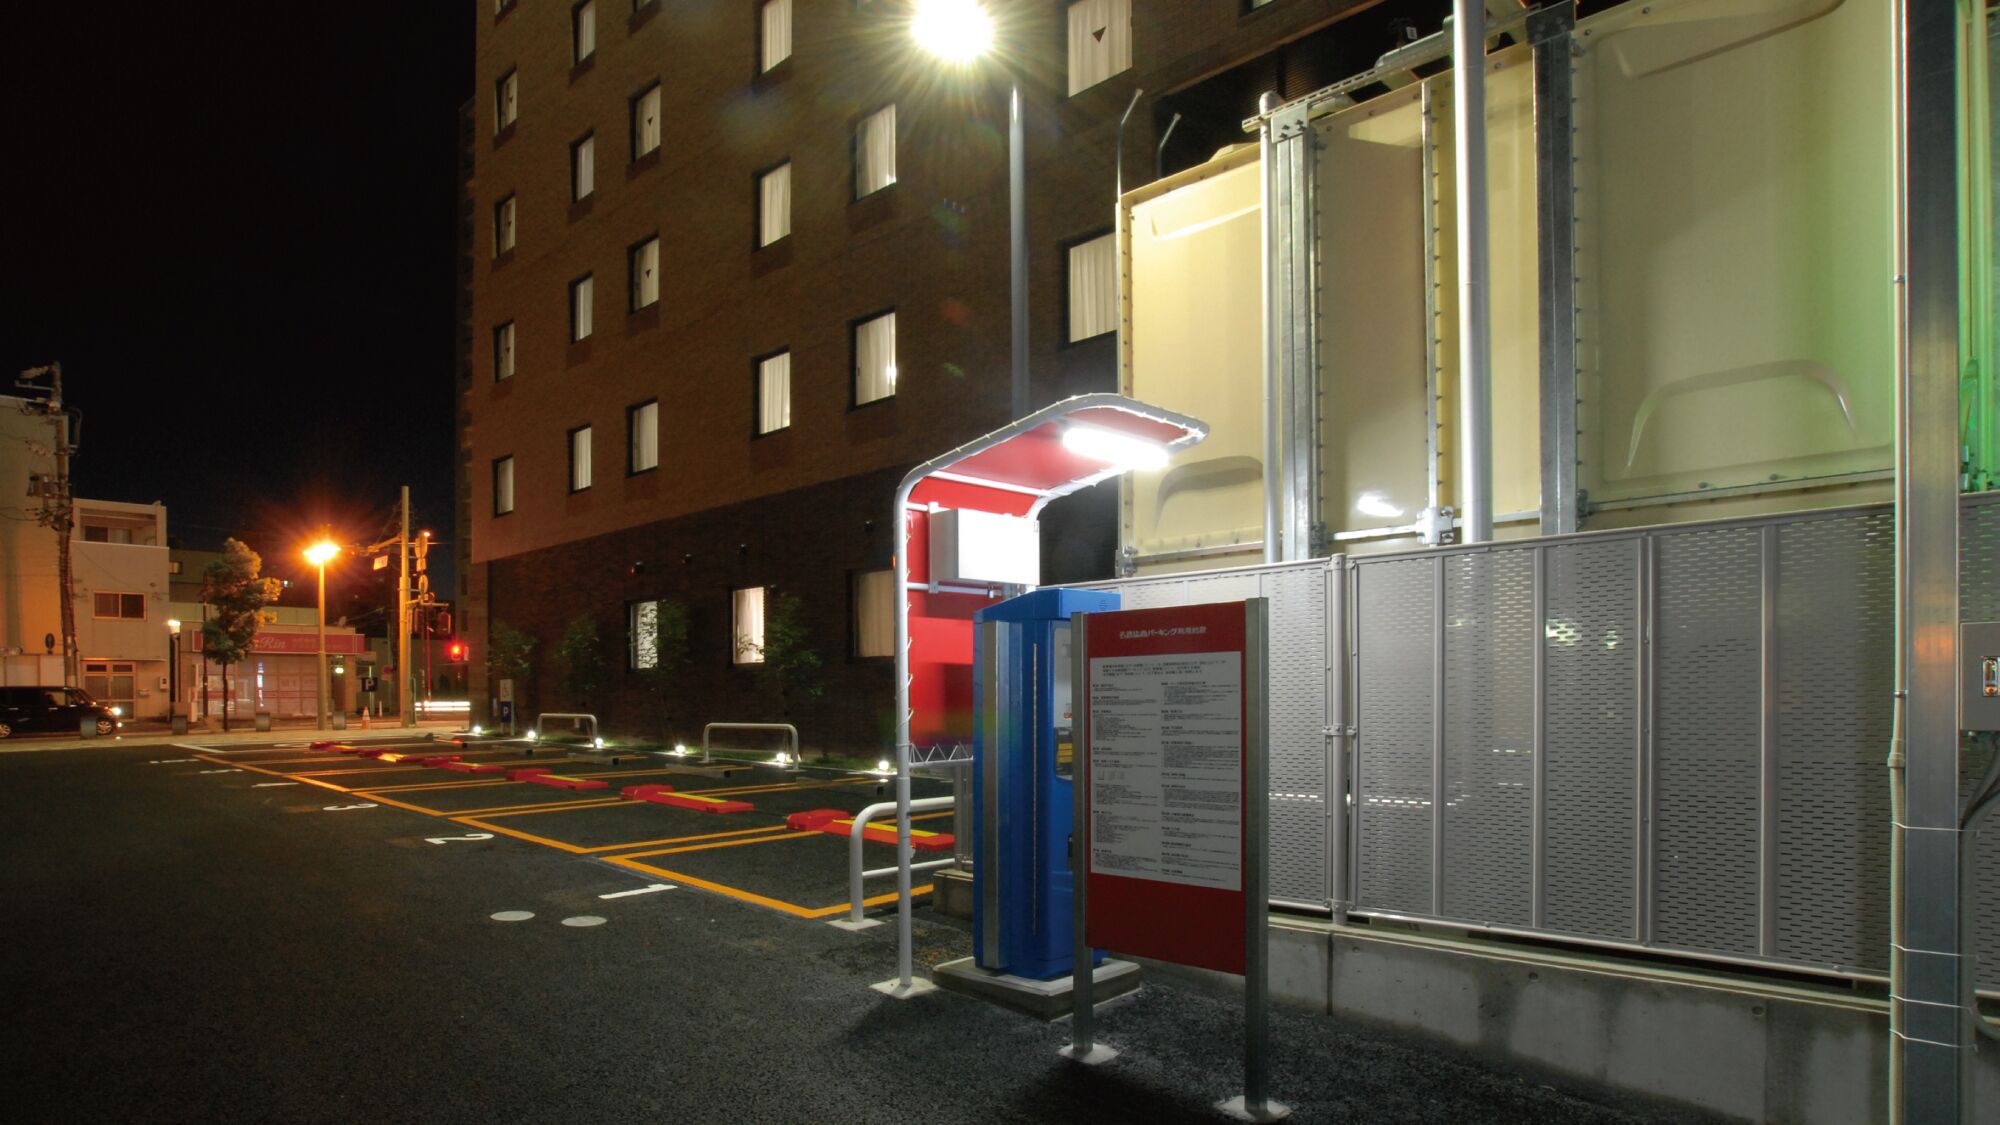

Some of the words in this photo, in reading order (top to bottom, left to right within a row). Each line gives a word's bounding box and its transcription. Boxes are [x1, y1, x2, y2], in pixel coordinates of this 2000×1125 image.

[365, 679, 374, 690] P
[503, 706, 510, 717] P
[424, 833, 495, 847] 2
[598, 883, 678, 901] 1
